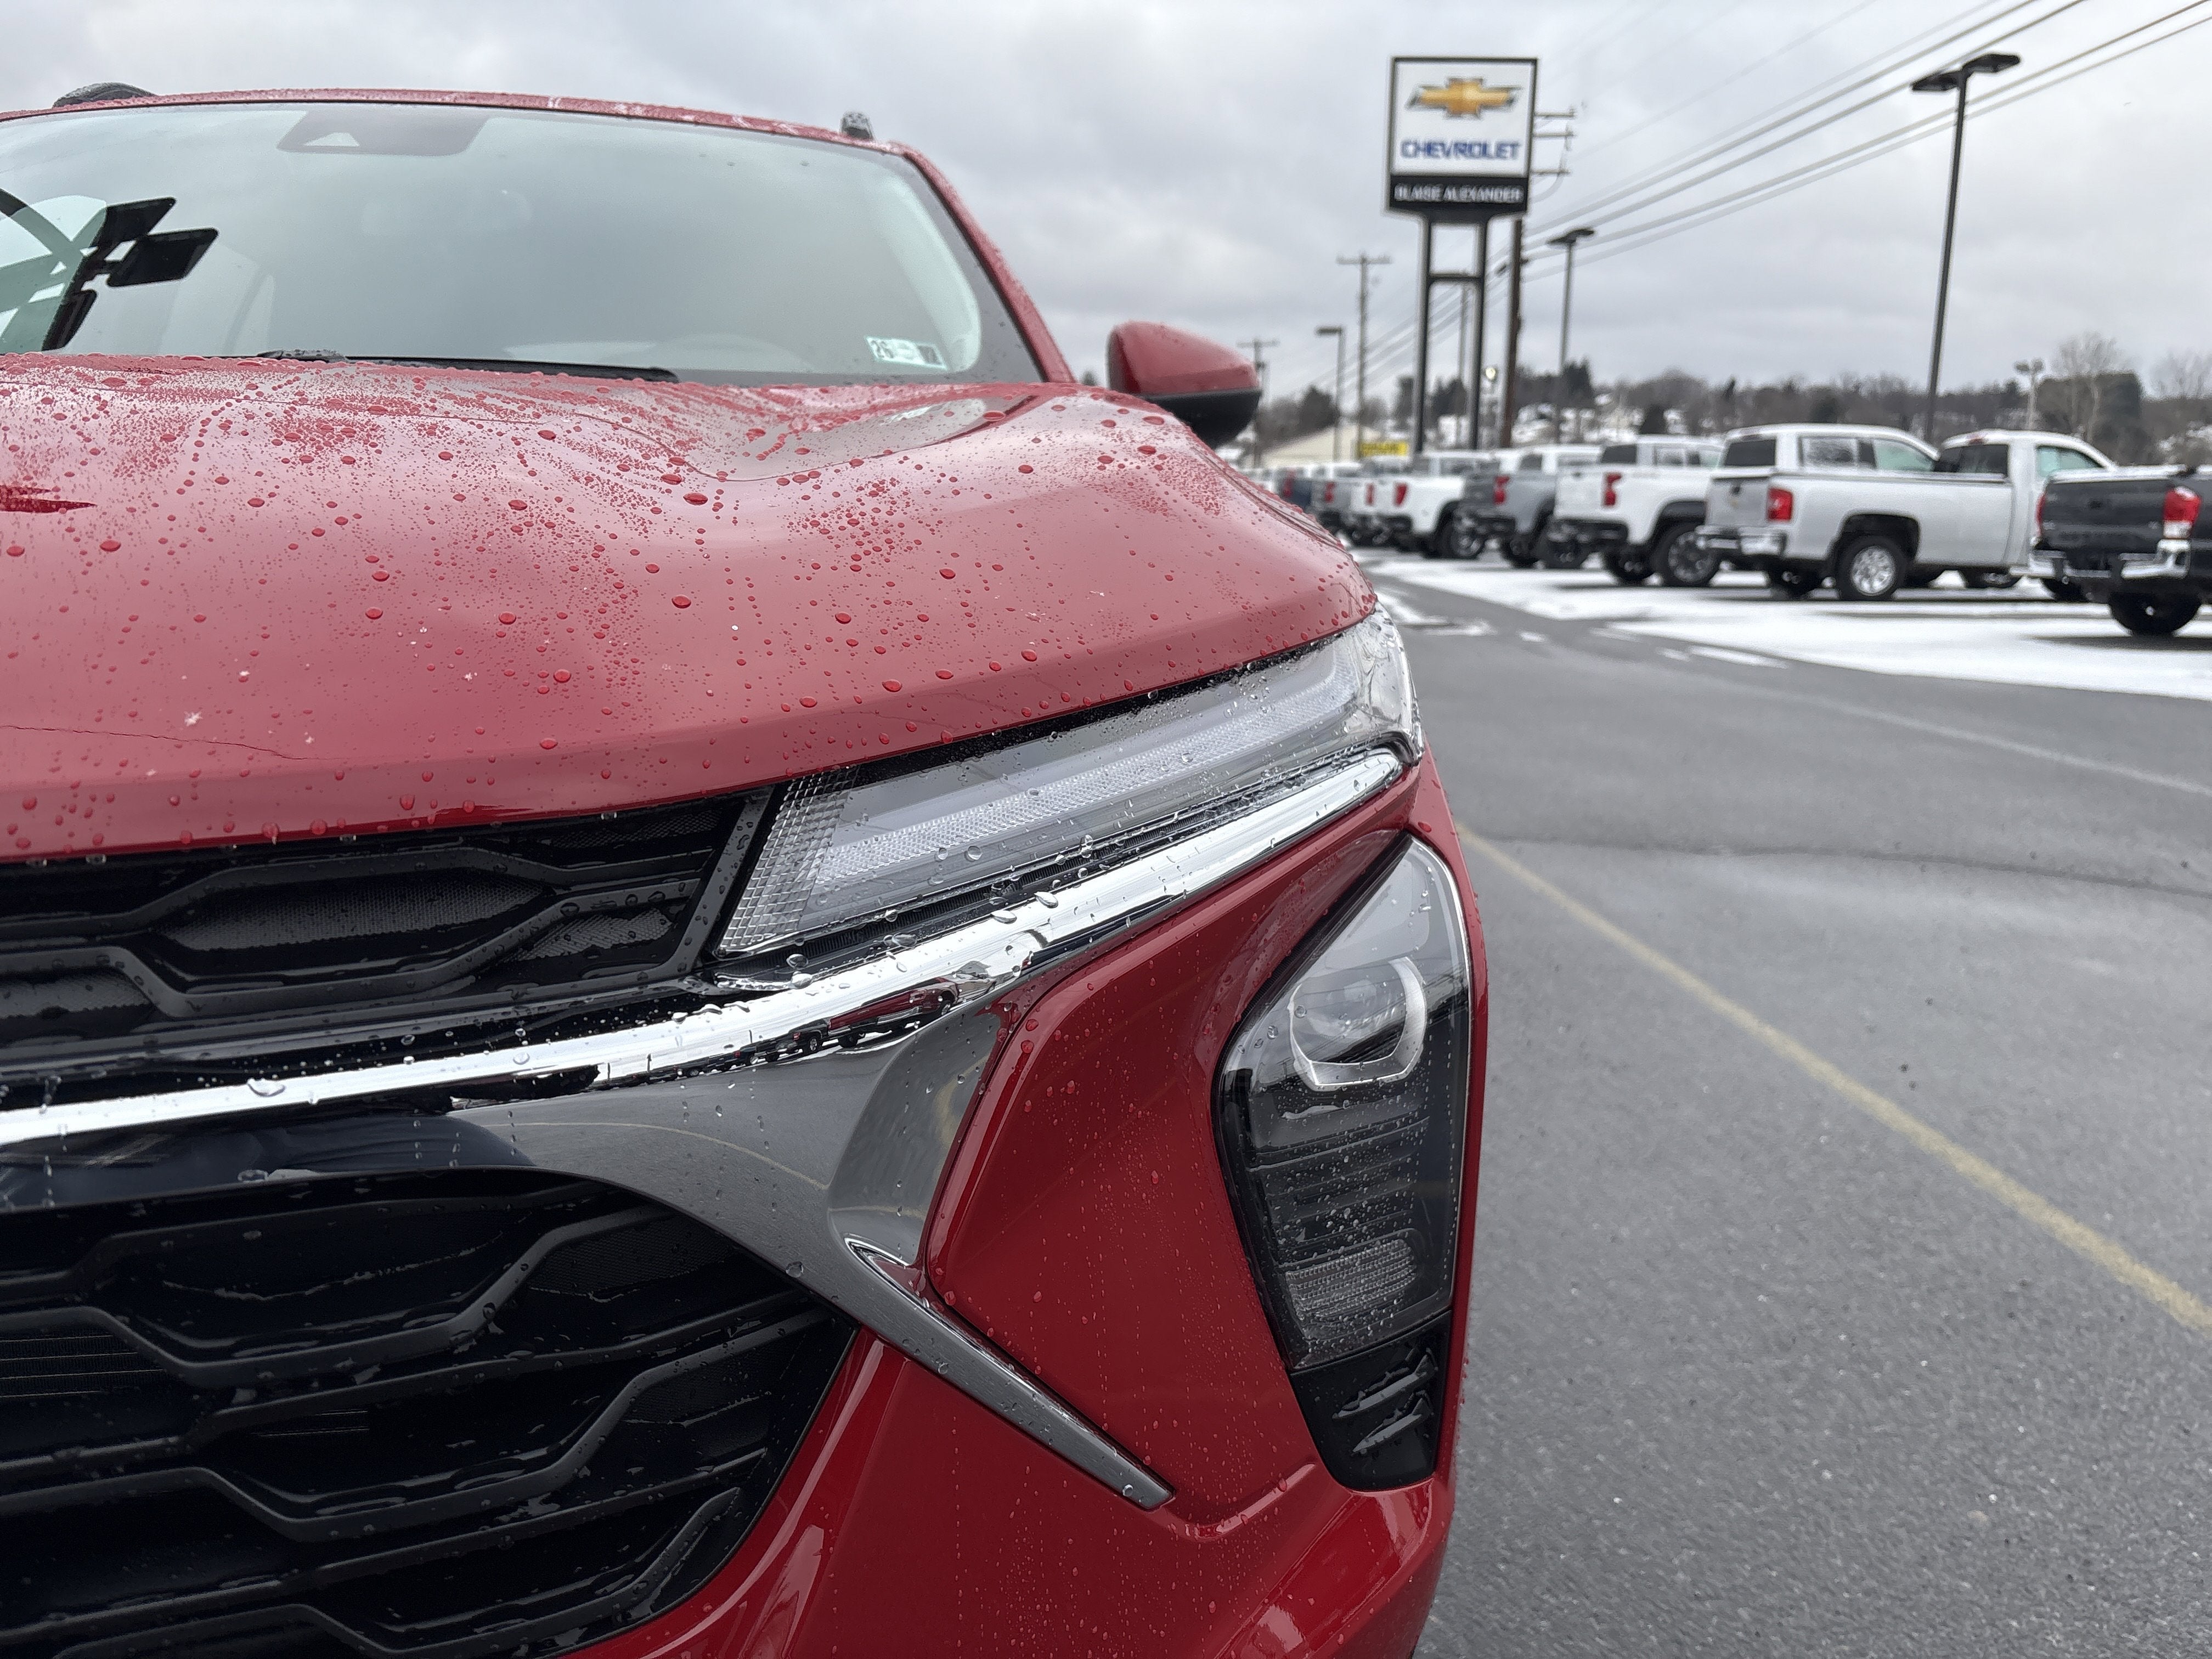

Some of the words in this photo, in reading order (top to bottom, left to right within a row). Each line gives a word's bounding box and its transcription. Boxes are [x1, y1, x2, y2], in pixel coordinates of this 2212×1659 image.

[1401, 141, 1519, 159] CHEVROLET
[1395, 184, 1442, 201] BLAISE
[1443, 185, 1523, 203] ALEXANDER
